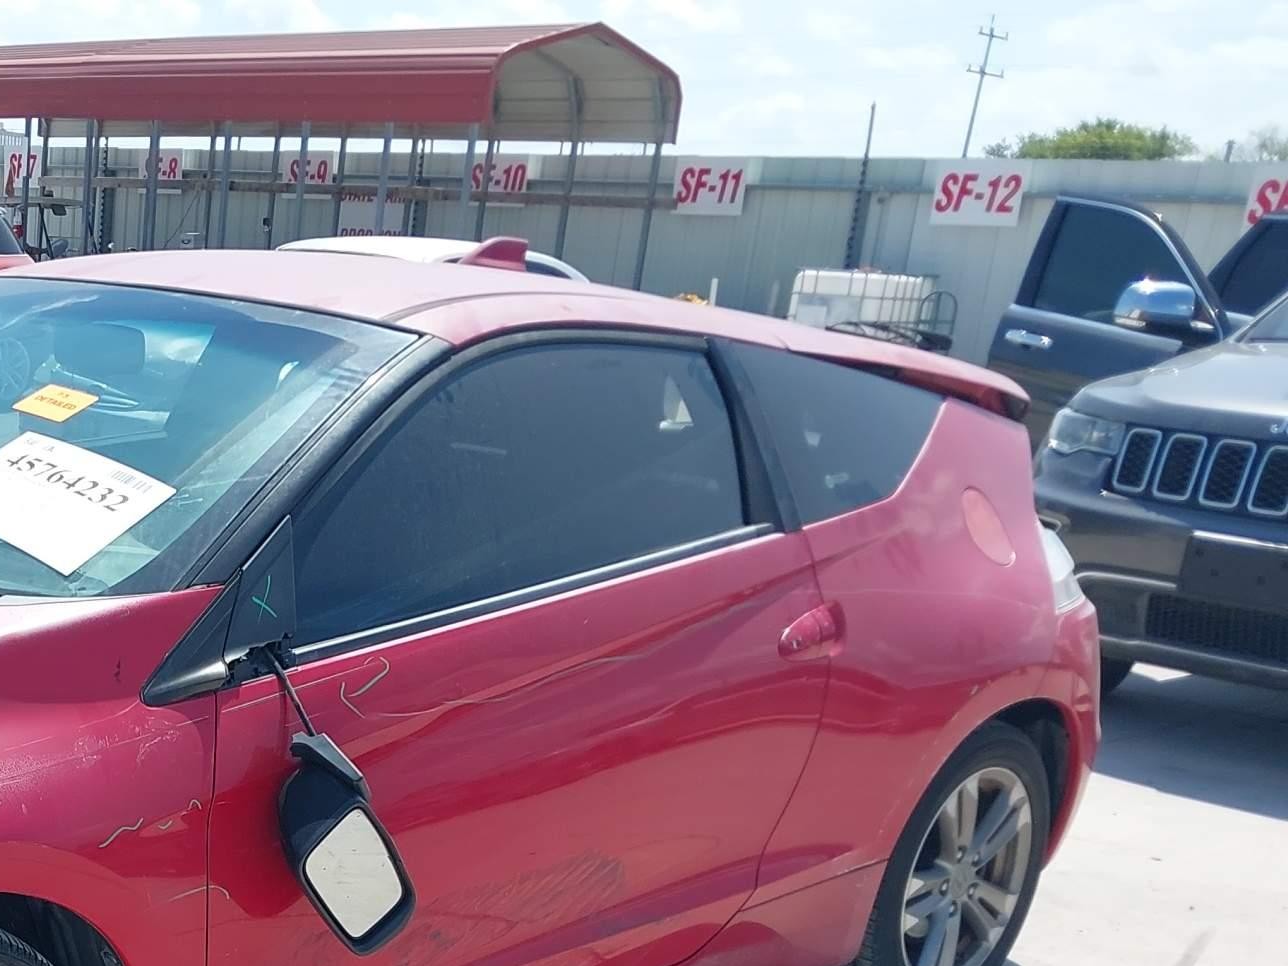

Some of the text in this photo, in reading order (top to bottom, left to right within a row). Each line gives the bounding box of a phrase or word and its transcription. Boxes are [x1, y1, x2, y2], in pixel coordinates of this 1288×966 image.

[676, 167, 743, 204] SF-11
[935, 172, 1022, 213] SF-12
[7, 455, 129, 511] 45764232
